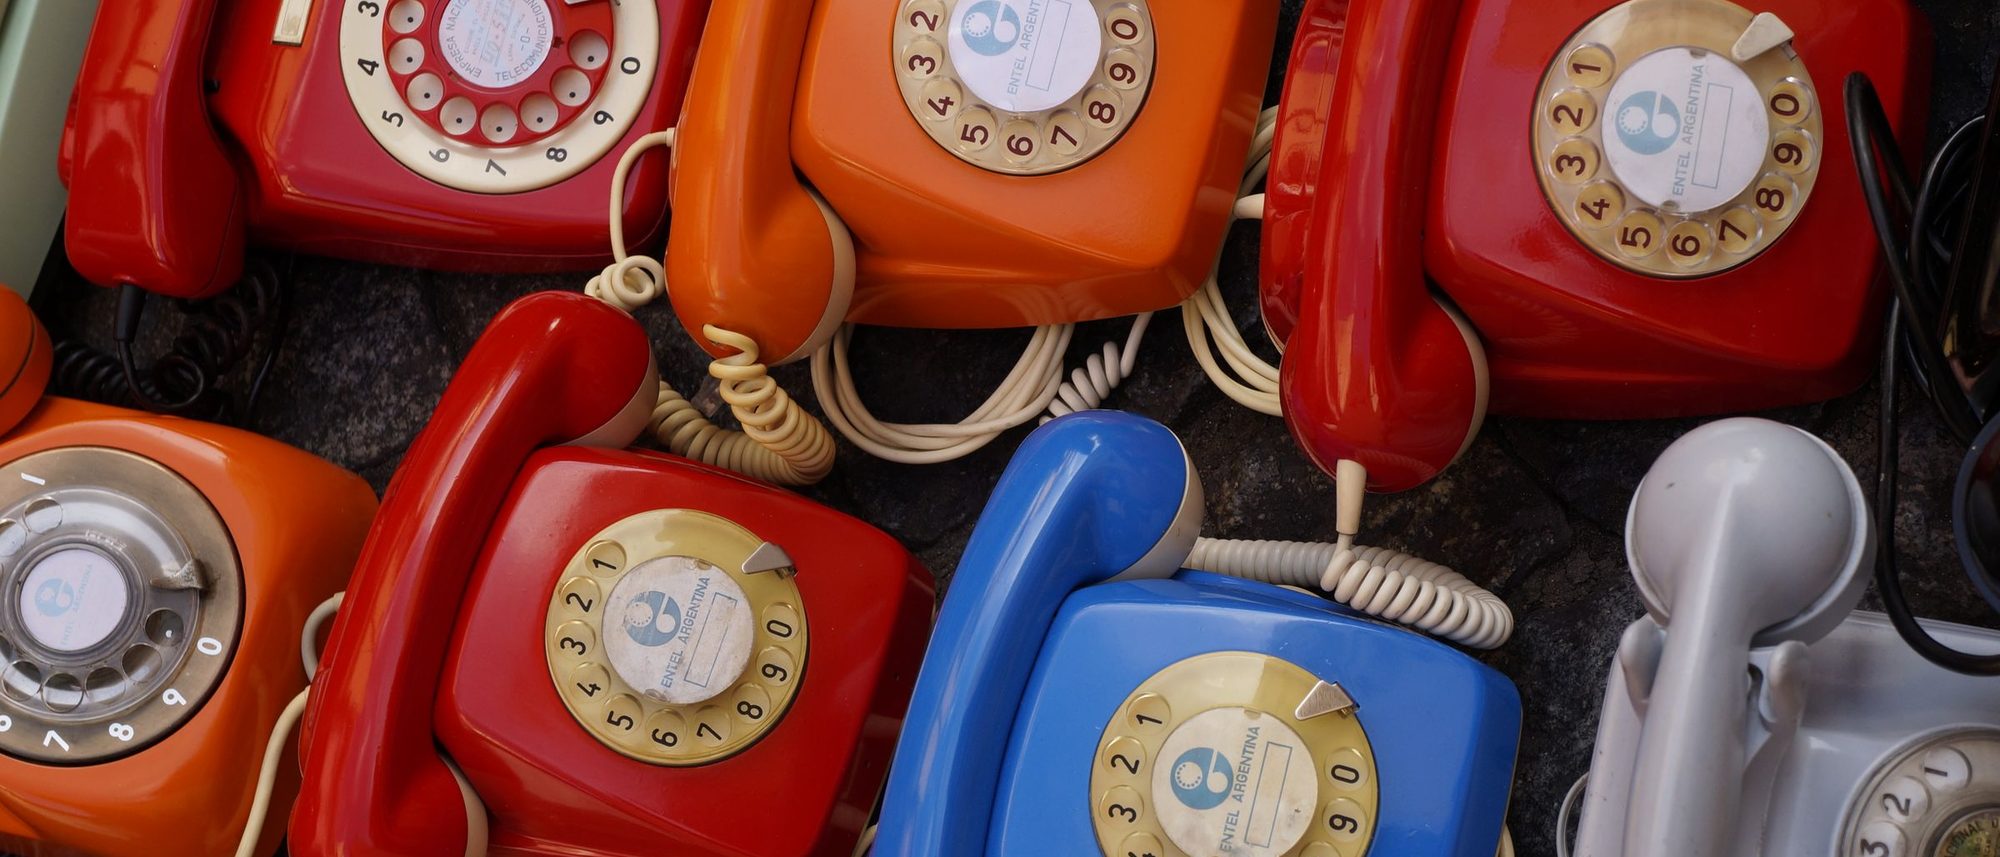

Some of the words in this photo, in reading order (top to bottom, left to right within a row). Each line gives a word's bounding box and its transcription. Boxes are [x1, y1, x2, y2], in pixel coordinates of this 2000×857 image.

[358, 0, 379, 17] 3
[910, 11, 938, 31] 2
[1111, 18, 1138, 40] 0
[357, 57, 379, 76] 4
[446, 36, 482, 79] EMPRESA
[620, 57, 641, 75] 0
[908, 54, 936, 75] 3
[1007, 56, 1026, 95] ENTEL
[1109, 62, 1136, 84] 9
[1572, 62, 1601, 75] 1
[927, 96, 954, 117] 4
[1088, 101, 1116, 124] 8
[1681, 64, 1705, 145] ARGENTINA
[1770, 93, 1799, 117] 0
[382, 109, 404, 127] 5
[593, 110, 614, 125] 9
[1553, 104, 1583, 127] 2
[961, 124, 989, 145] 5
[1006, 134, 1034, 156] 6
[1050, 125, 1078, 148] 7
[429, 148, 450, 163] 6
[546, 146, 568, 163] 8
[1555, 154, 1586, 176] 3
[1773, 143, 1803, 166] 9
[485, 158, 507, 177] 7
[1672, 150, 1691, 197] ENTEL
[1580, 198, 1610, 221] 4
[1755, 187, 1784, 212] 8
[1621, 226, 1651, 249] 5
[1718, 219, 1748, 243] 7
[1671, 234, 1700, 257] 6
[20, 472, 45, 485] 1
[592, 558, 617, 571] 1
[565, 592, 593, 613] 2
[660, 650, 684, 689] ENTEL
[681, 576, 710, 645] ARGENTINA
[766, 619, 792, 638] 0
[197, 636, 222, 656] 0
[560, 637, 586, 656] 3
[761, 663, 788, 682] 9
[162, 688, 187, 706] 9
[576, 681, 601, 697] 4
[607, 710, 634, 731] 5
[737, 700, 763, 720] 8
[1136, 713, 1162, 725] 1
[42, 729, 70, 752] 7
[108, 722, 134, 742] 8
[651, 728, 678, 747] 6
[696, 722, 722, 741] 7
[1110, 754, 1140, 775] 2
[1330, 764, 1360, 784] 0
[1924, 766, 1948, 777] 1
[1219, 809, 1240, 853] ENTEL
[1231, 726, 1260, 803] ARGENTINA
[1108, 803, 1137, 823] 3
[1882, 793, 1911, 816] 2
[1329, 813, 1358, 834] 9
